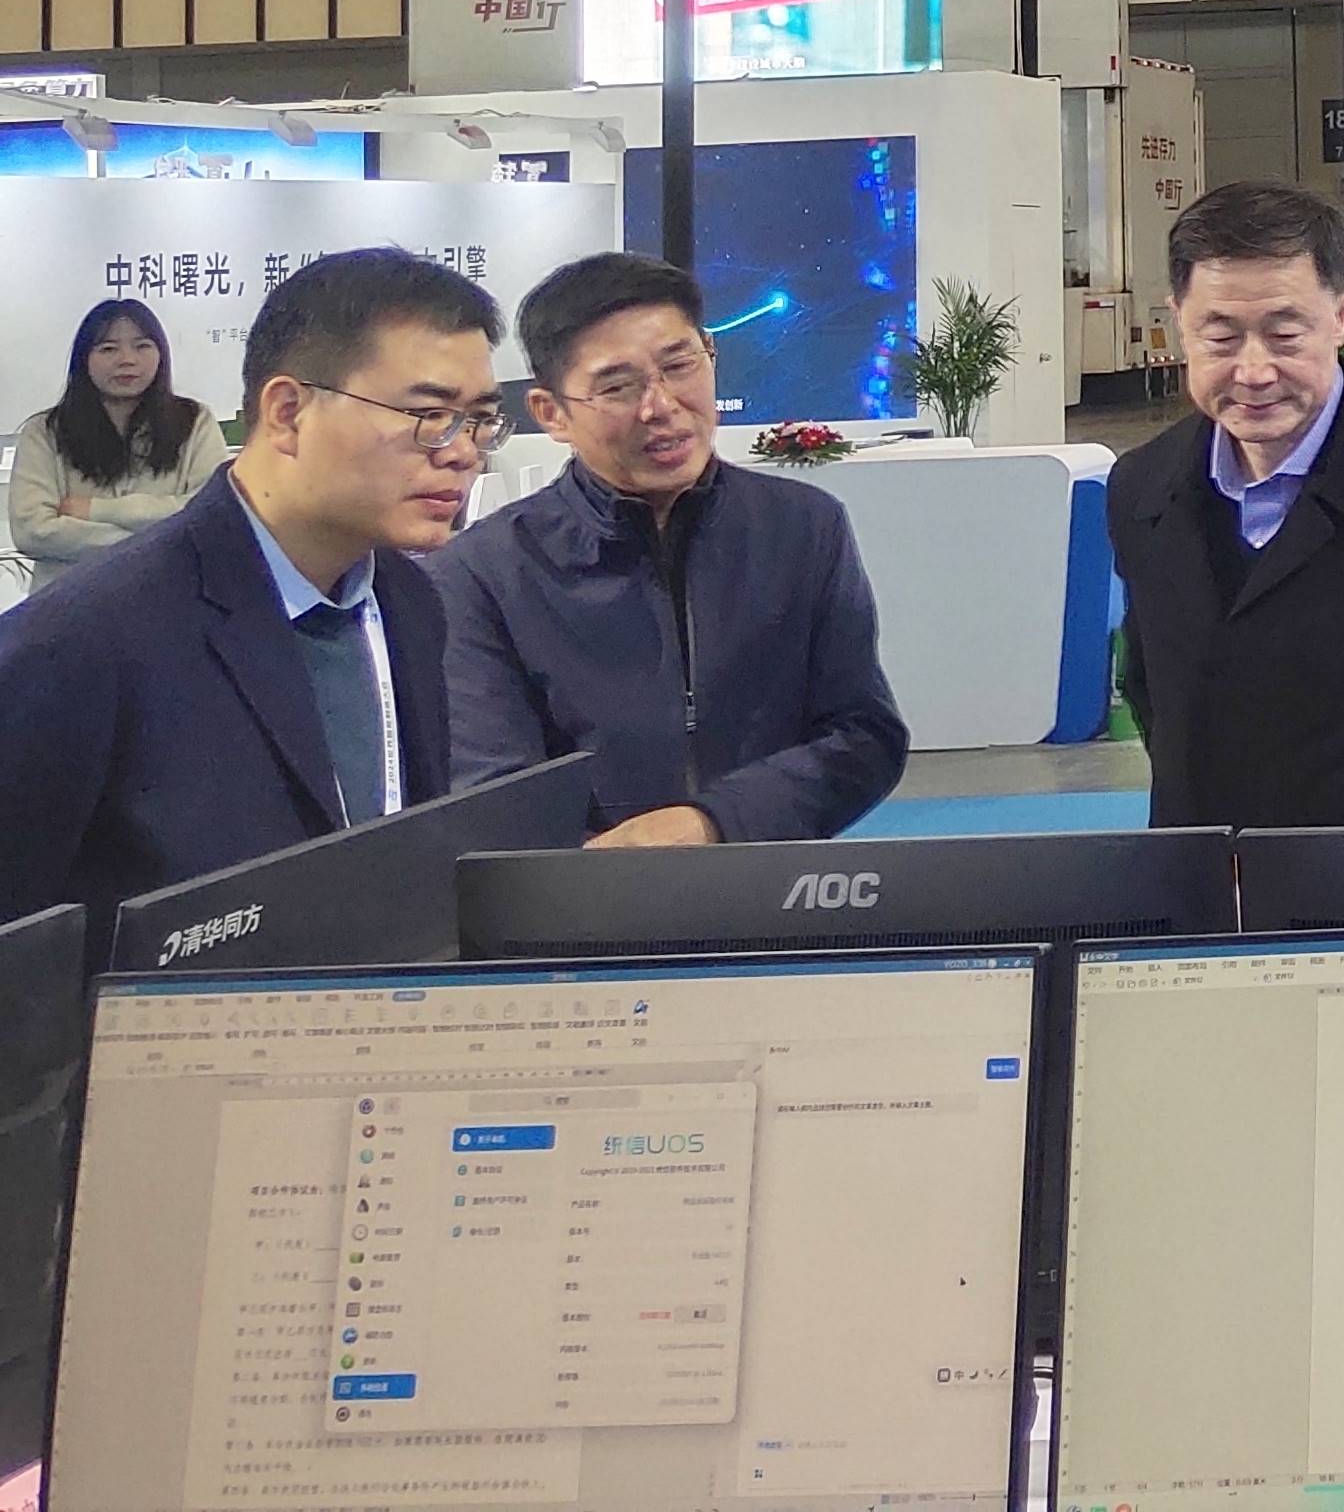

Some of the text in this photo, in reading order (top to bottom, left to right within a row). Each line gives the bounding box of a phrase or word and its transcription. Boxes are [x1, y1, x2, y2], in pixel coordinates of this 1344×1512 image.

[782, 872, 881, 912] AOC
[182, 903, 263, 956] 清华同方
